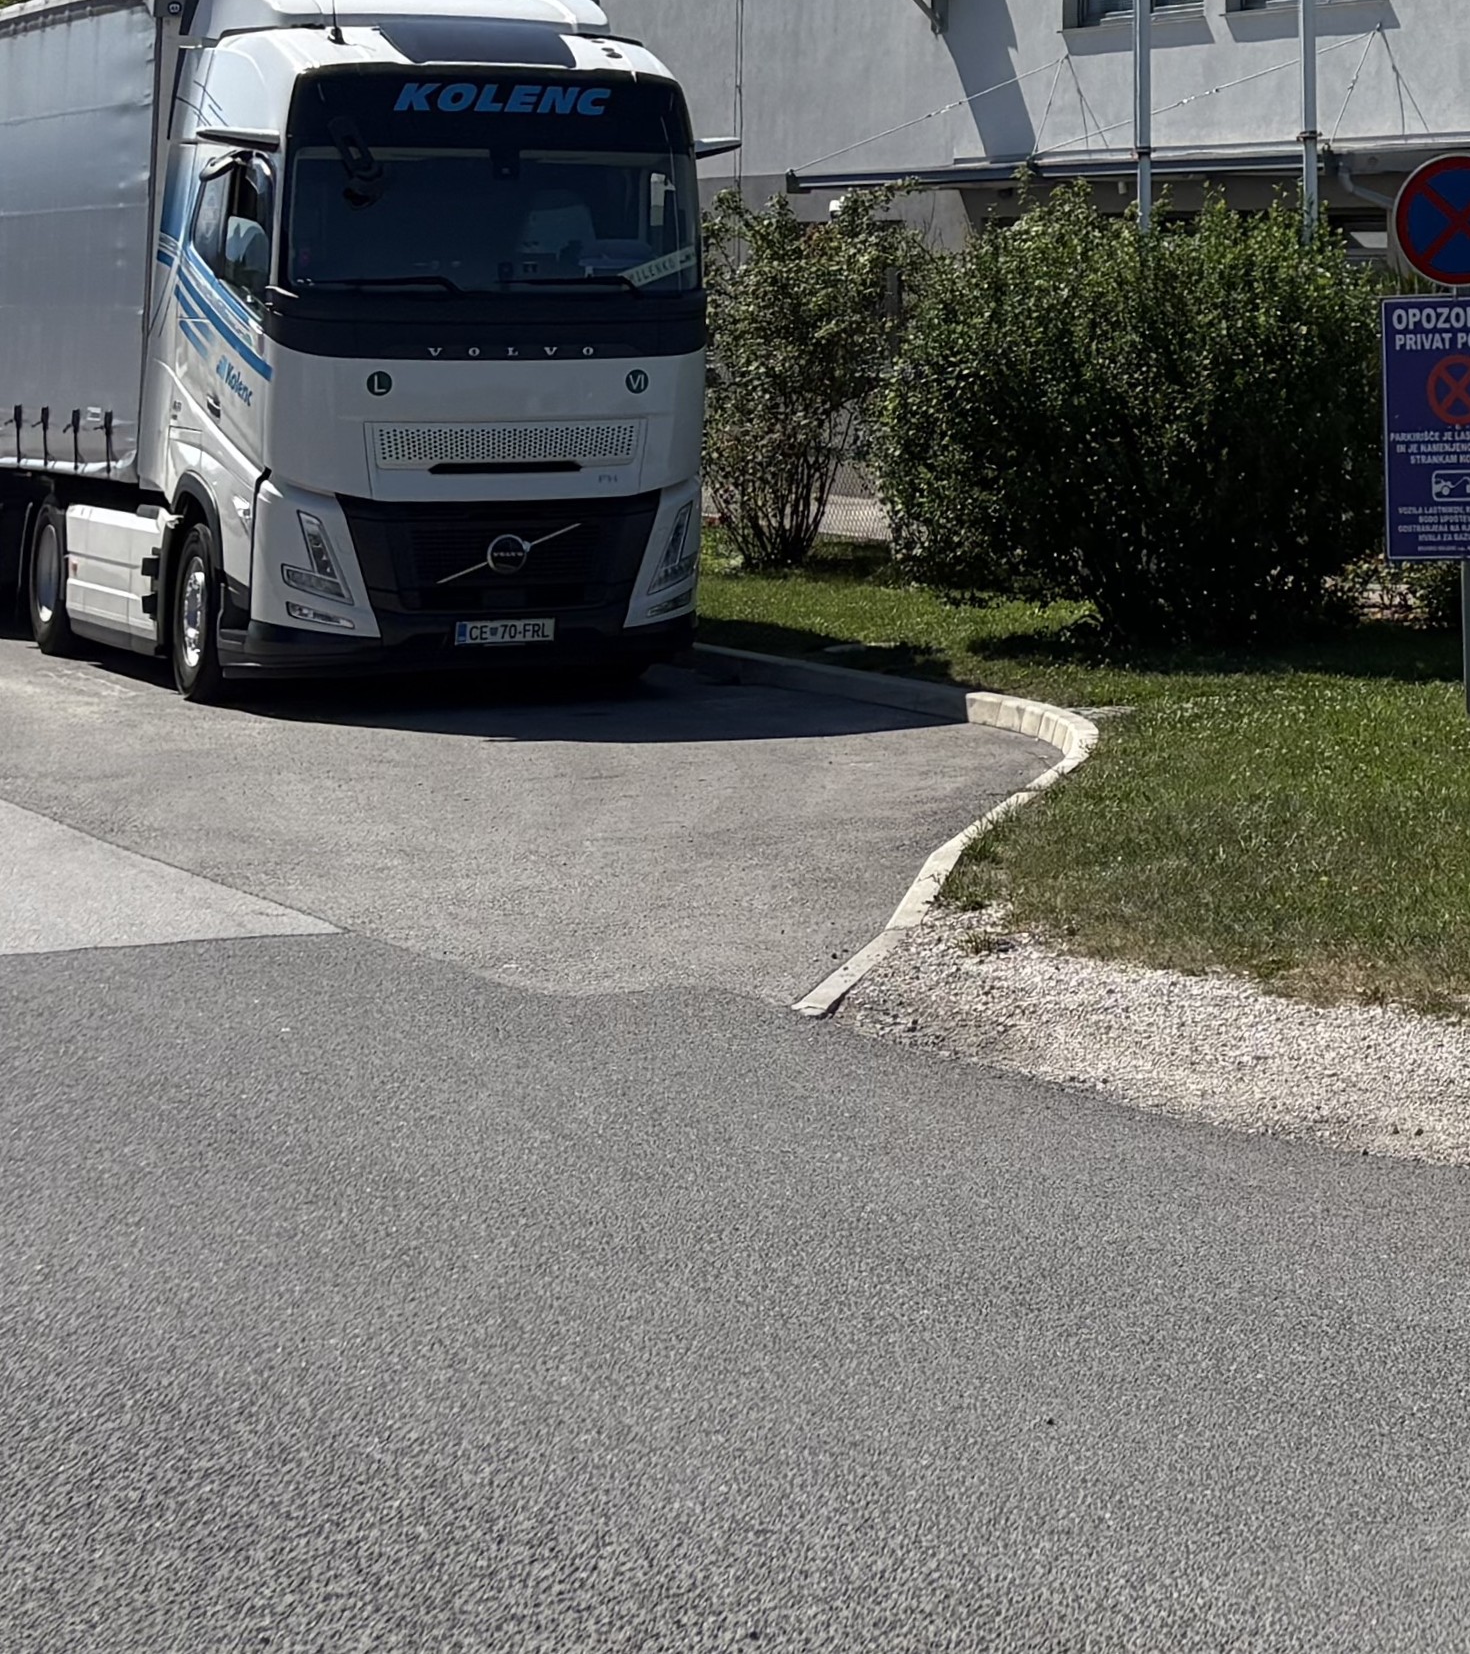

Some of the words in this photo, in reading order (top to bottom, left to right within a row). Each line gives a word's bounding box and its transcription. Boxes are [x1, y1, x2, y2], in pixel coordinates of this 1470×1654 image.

[394, 83, 611, 116] KOLENC
[1395, 332, 1452, 350] PRIVAT
[428, 347, 594, 357] VOLVO
[374, 375, 386, 393] L
[1442, 431, 1453, 441] JE
[469, 625, 489, 641] CE
